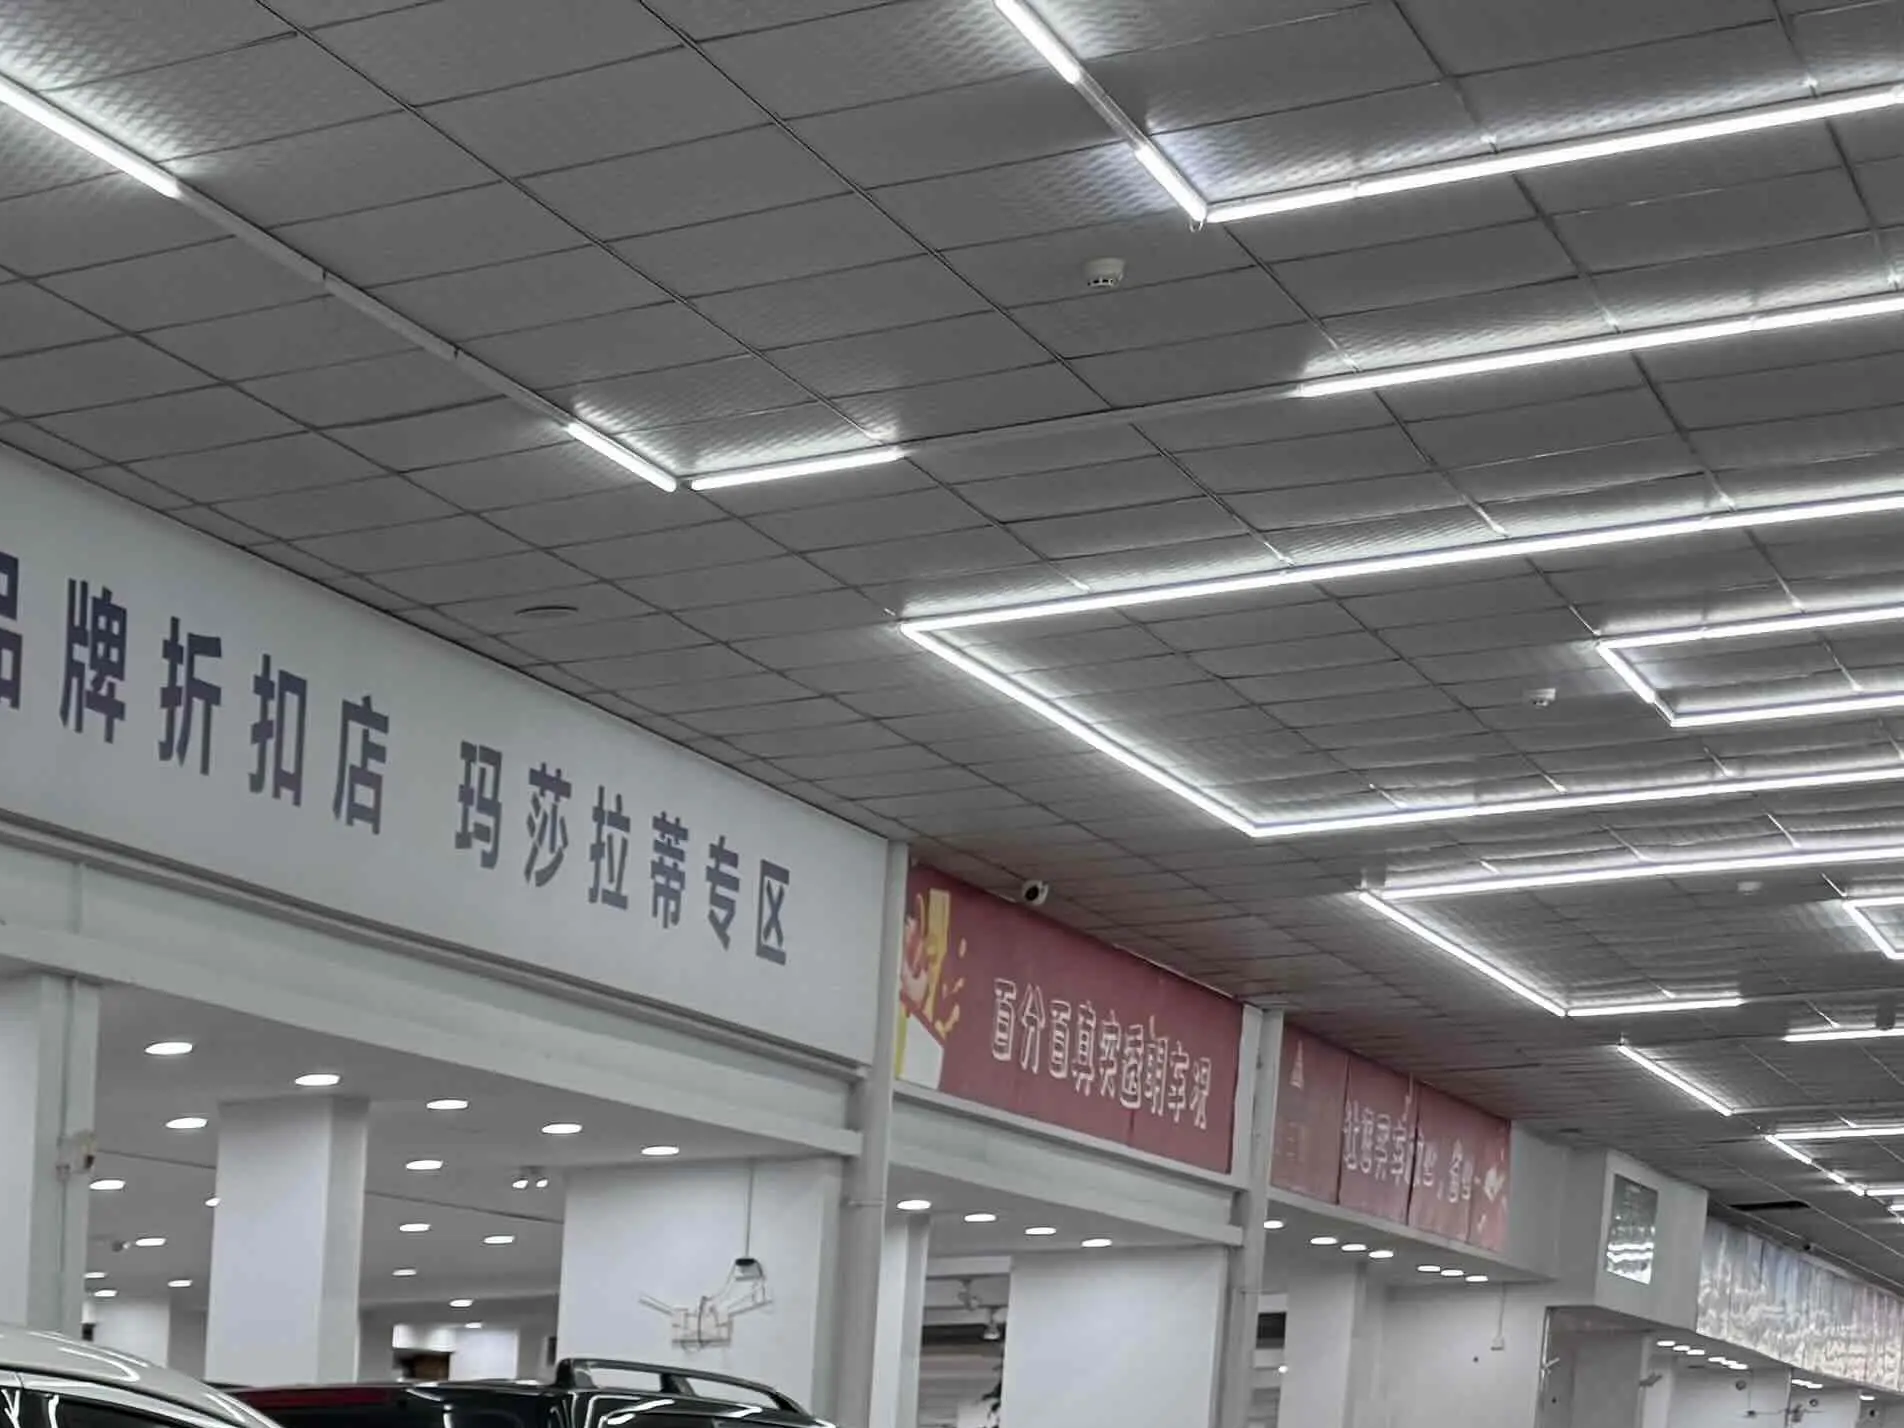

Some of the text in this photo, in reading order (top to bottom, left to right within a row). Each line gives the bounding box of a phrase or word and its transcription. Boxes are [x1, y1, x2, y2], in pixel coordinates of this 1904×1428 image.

[454, 740, 791, 967] 玛莎拉蒂专区
